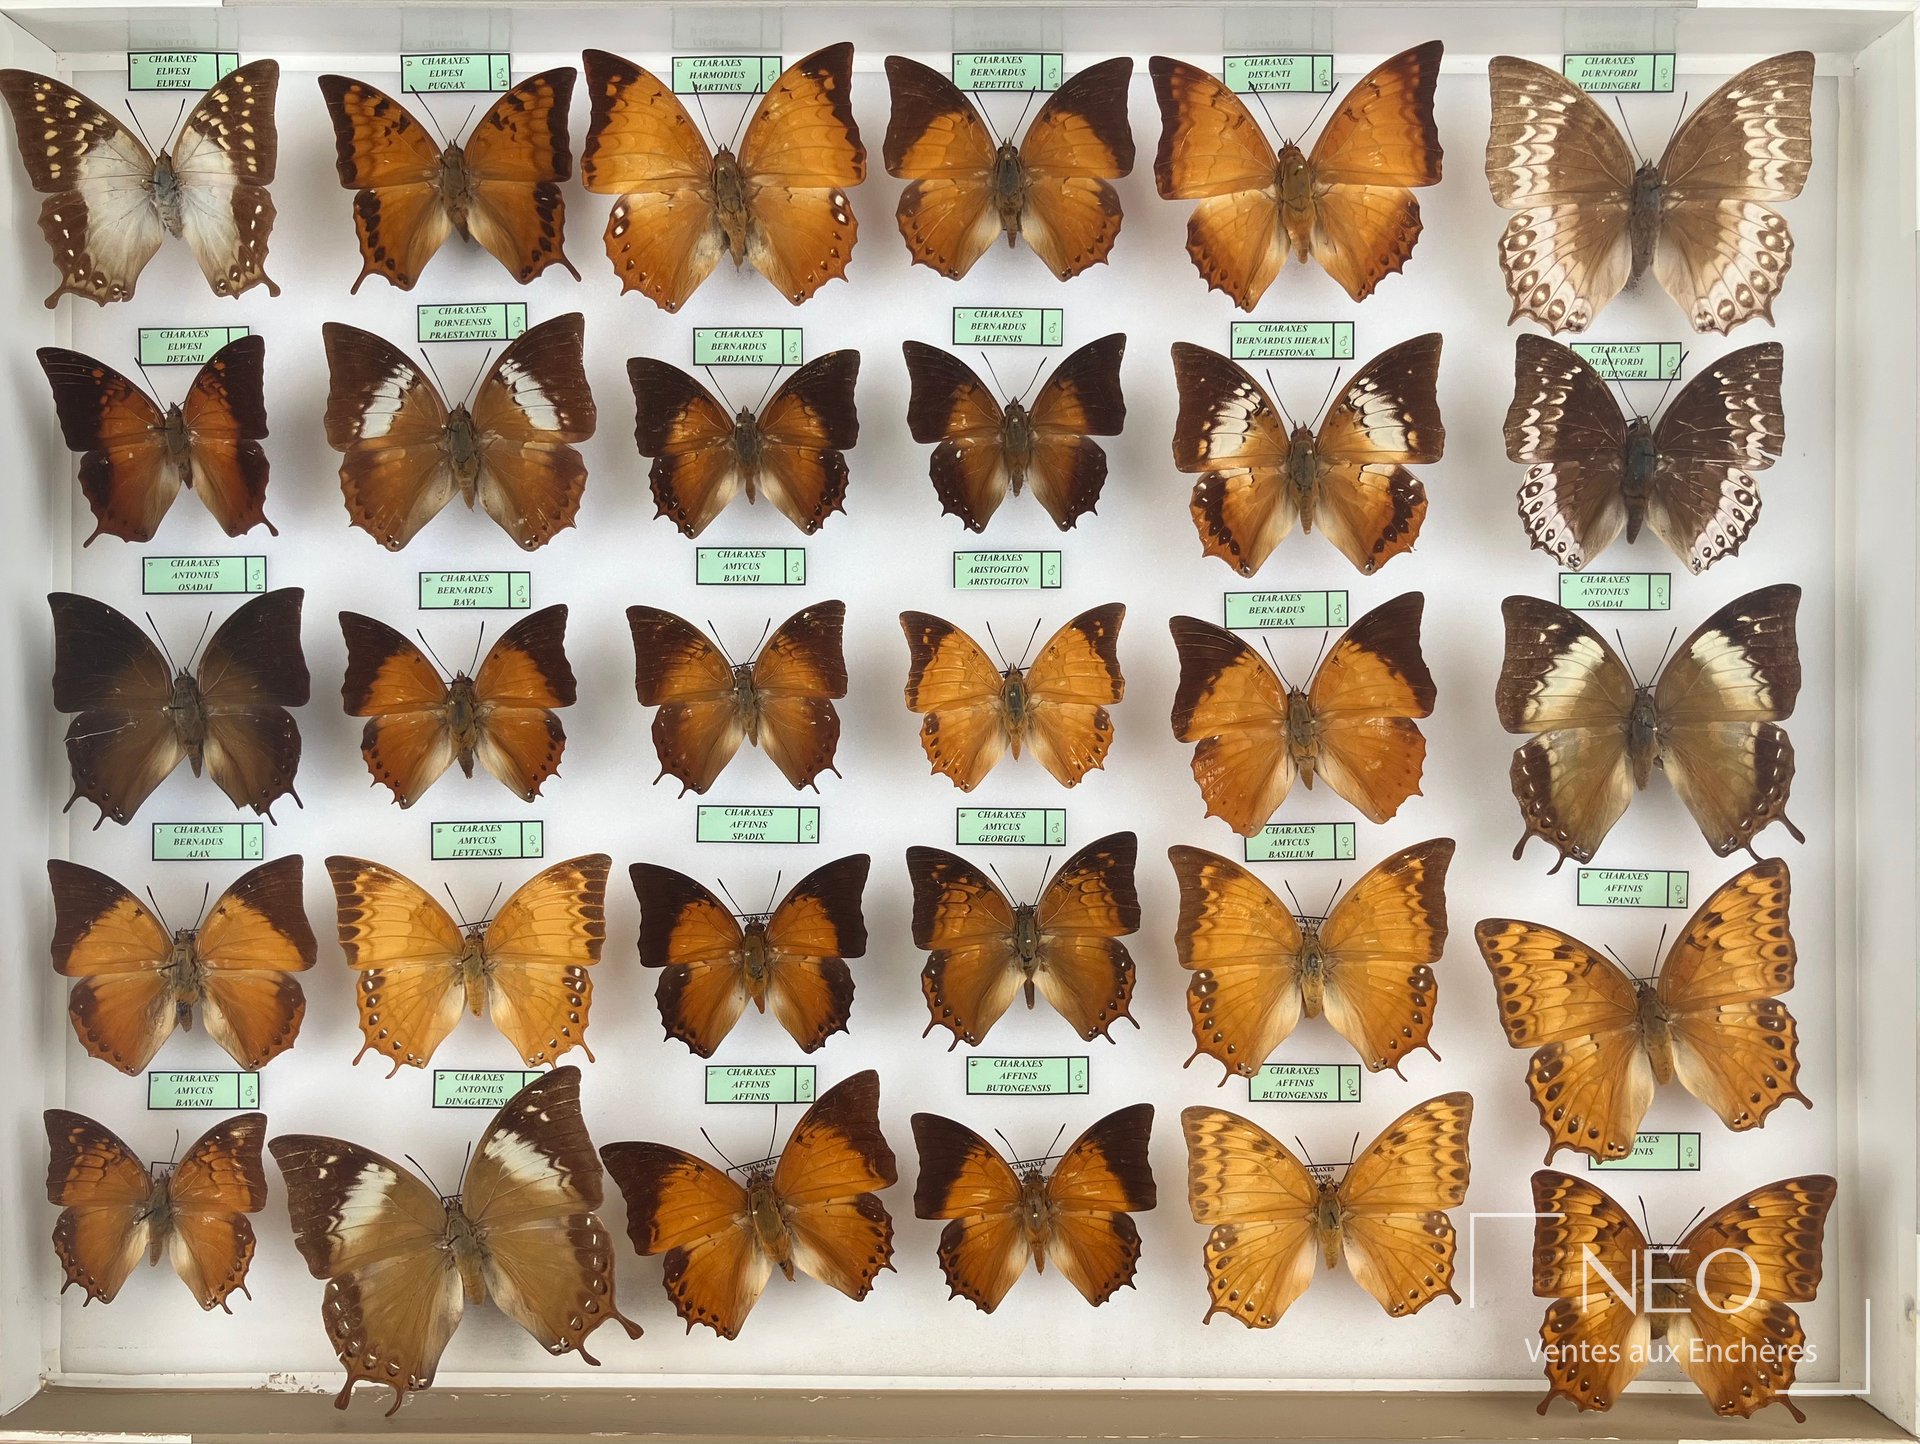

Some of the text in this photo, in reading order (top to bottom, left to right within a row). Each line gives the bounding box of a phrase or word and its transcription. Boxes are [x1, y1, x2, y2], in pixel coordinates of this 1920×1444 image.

[148, 54, 198, 63] CHARAXES
[421, 57, 471, 65] CHARAXES
[973, 56, 1023, 65] CHARAXES
[1243, 58, 1294, 67] CHARAXES
[1584, 57, 1635, 66] CHARAXES
[692, 59, 742, 68] CHARAXES
[155, 67, 191, 76] ELWESI
[429, 69, 463, 78] ELWESI
[689, 71, 746, 80] HARMODIUS
[970, 68, 1027, 77] BERNARDUS
[1247, 70, 1291, 79] DISTANTI
[1581, 69, 1638, 78] DURNFORDI
[156, 79, 191, 88] ELWESI
[427, 81, 466, 90] PUGNAX
[694, 82, 742, 91] MARTINUS
[972, 80, 1024, 89] REPETITUS
[1248, 82, 1291, 91] DISTANTI
[1578, 81, 1641, 90] STAUDINGERI
[438, 306, 487, 315] CHARAXES
[974, 310, 1024, 319] CHARAXES
[433, 318, 492, 327] BORNEENSIS
[970, 322, 1027, 331] BERNARDUS
[1258, 324, 1308, 333] CHARAXES
[160, 330, 210, 339] CHARAXES
[429, 330, 498, 339] PRAESTANTIUS
[714, 330, 764, 339] CHARAXES
[974, 334, 1023, 343] BALIENSIS
[1236, 336, 1330, 345] BERNARDUS HIERAX
[167, 342, 203, 351] ELWESI
[711, 342, 767, 351] BERNARDUS
[1590, 345, 1641, 354] CHARAXES
[1248, 348, 1316, 358] f. PLEISTONAX
[166, 354, 205, 363] DETANII
[714, 354, 764, 363] ARDJANUS
[1599, 369, 1647, 378] UDINGERI
[717, 550, 767, 559] CHARAXES
[973, 554, 1023, 562] CHARAXES
[170, 559, 220, 568] CHARAXES
[722, 562, 761, 571] AMYCUS
[967, 565, 1030, 574] ARISTOGITON
[171, 571, 220, 580] ANTONIUS
[440, 574, 490, 583] CHARAXES
[723, 574, 760, 583] BAYANII
[967, 577, 1030, 586] ARISTOGITON
[1580, 576, 1631, 585] CHARAXES
[178, 583, 213, 592] OSADAI
[437, 586, 494, 595] BERNARDUS
[1581, 588, 1630, 596] ANTONIUS
[453, 598, 477, 607] BAYA
[1251, 594, 1302, 603] CHARAXES
[1587, 600, 1623, 609] OSADAI
[1248, 606, 1305, 615] BERNARDUS
[1259, 618, 1296, 627] HIERAX
[724, 808, 774, 817] CHARAXES
[977, 811, 1027, 820] CHARAXES
[452, 824, 502, 833] CHARAXES
[729, 820, 768, 829] AFFINIS
[982, 822, 1021, 831] AMYCUS
[173, 826, 224, 835] CHARAXES
[1265, 826, 1316, 835] CHARAXES
[457, 836, 497, 845] AMYCUS
[731, 832, 765, 841] SPADIX
[978, 834, 1026, 843] GEORGIUS
[173, 837, 224, 846] BERNADUS
[1271, 838, 1310, 847] AMYCUS
[186, 850, 211, 859] AJAX
[452, 848, 503, 857] LEYTENSIS
[1268, 850, 1314, 859] BASILIUM
[1598, 872, 1650, 881] CHARAXES
[1604, 884, 1643, 893] AFFINIS
[1606, 896, 1641, 905] SPANIX
[993, 1059, 1043, 1068] CHARAXES
[726, 1068, 776, 1077] CHARAXES
[1269, 1066, 1320, 1075] CHARAXES
[169, 1074, 220, 1083] CHARAXES
[455, 1073, 505, 1082] CHARAXES
[999, 1071, 1038, 1080] AFFINIS
[731, 1080, 770, 1089] AFFINIS
[1275, 1078, 1314, 1087] AFFINIS
[175, 1086, 214, 1095] AMYCUS
[455, 1085, 503, 1094] ANTONIUS
[986, 1083, 1051, 1092] BUTONGENSIS
[731, 1092, 770, 1101] AFFINIS
[1262, 1090, 1328, 1100] BUTONGENSIS
[175, 1098, 213, 1107] BAYANII
